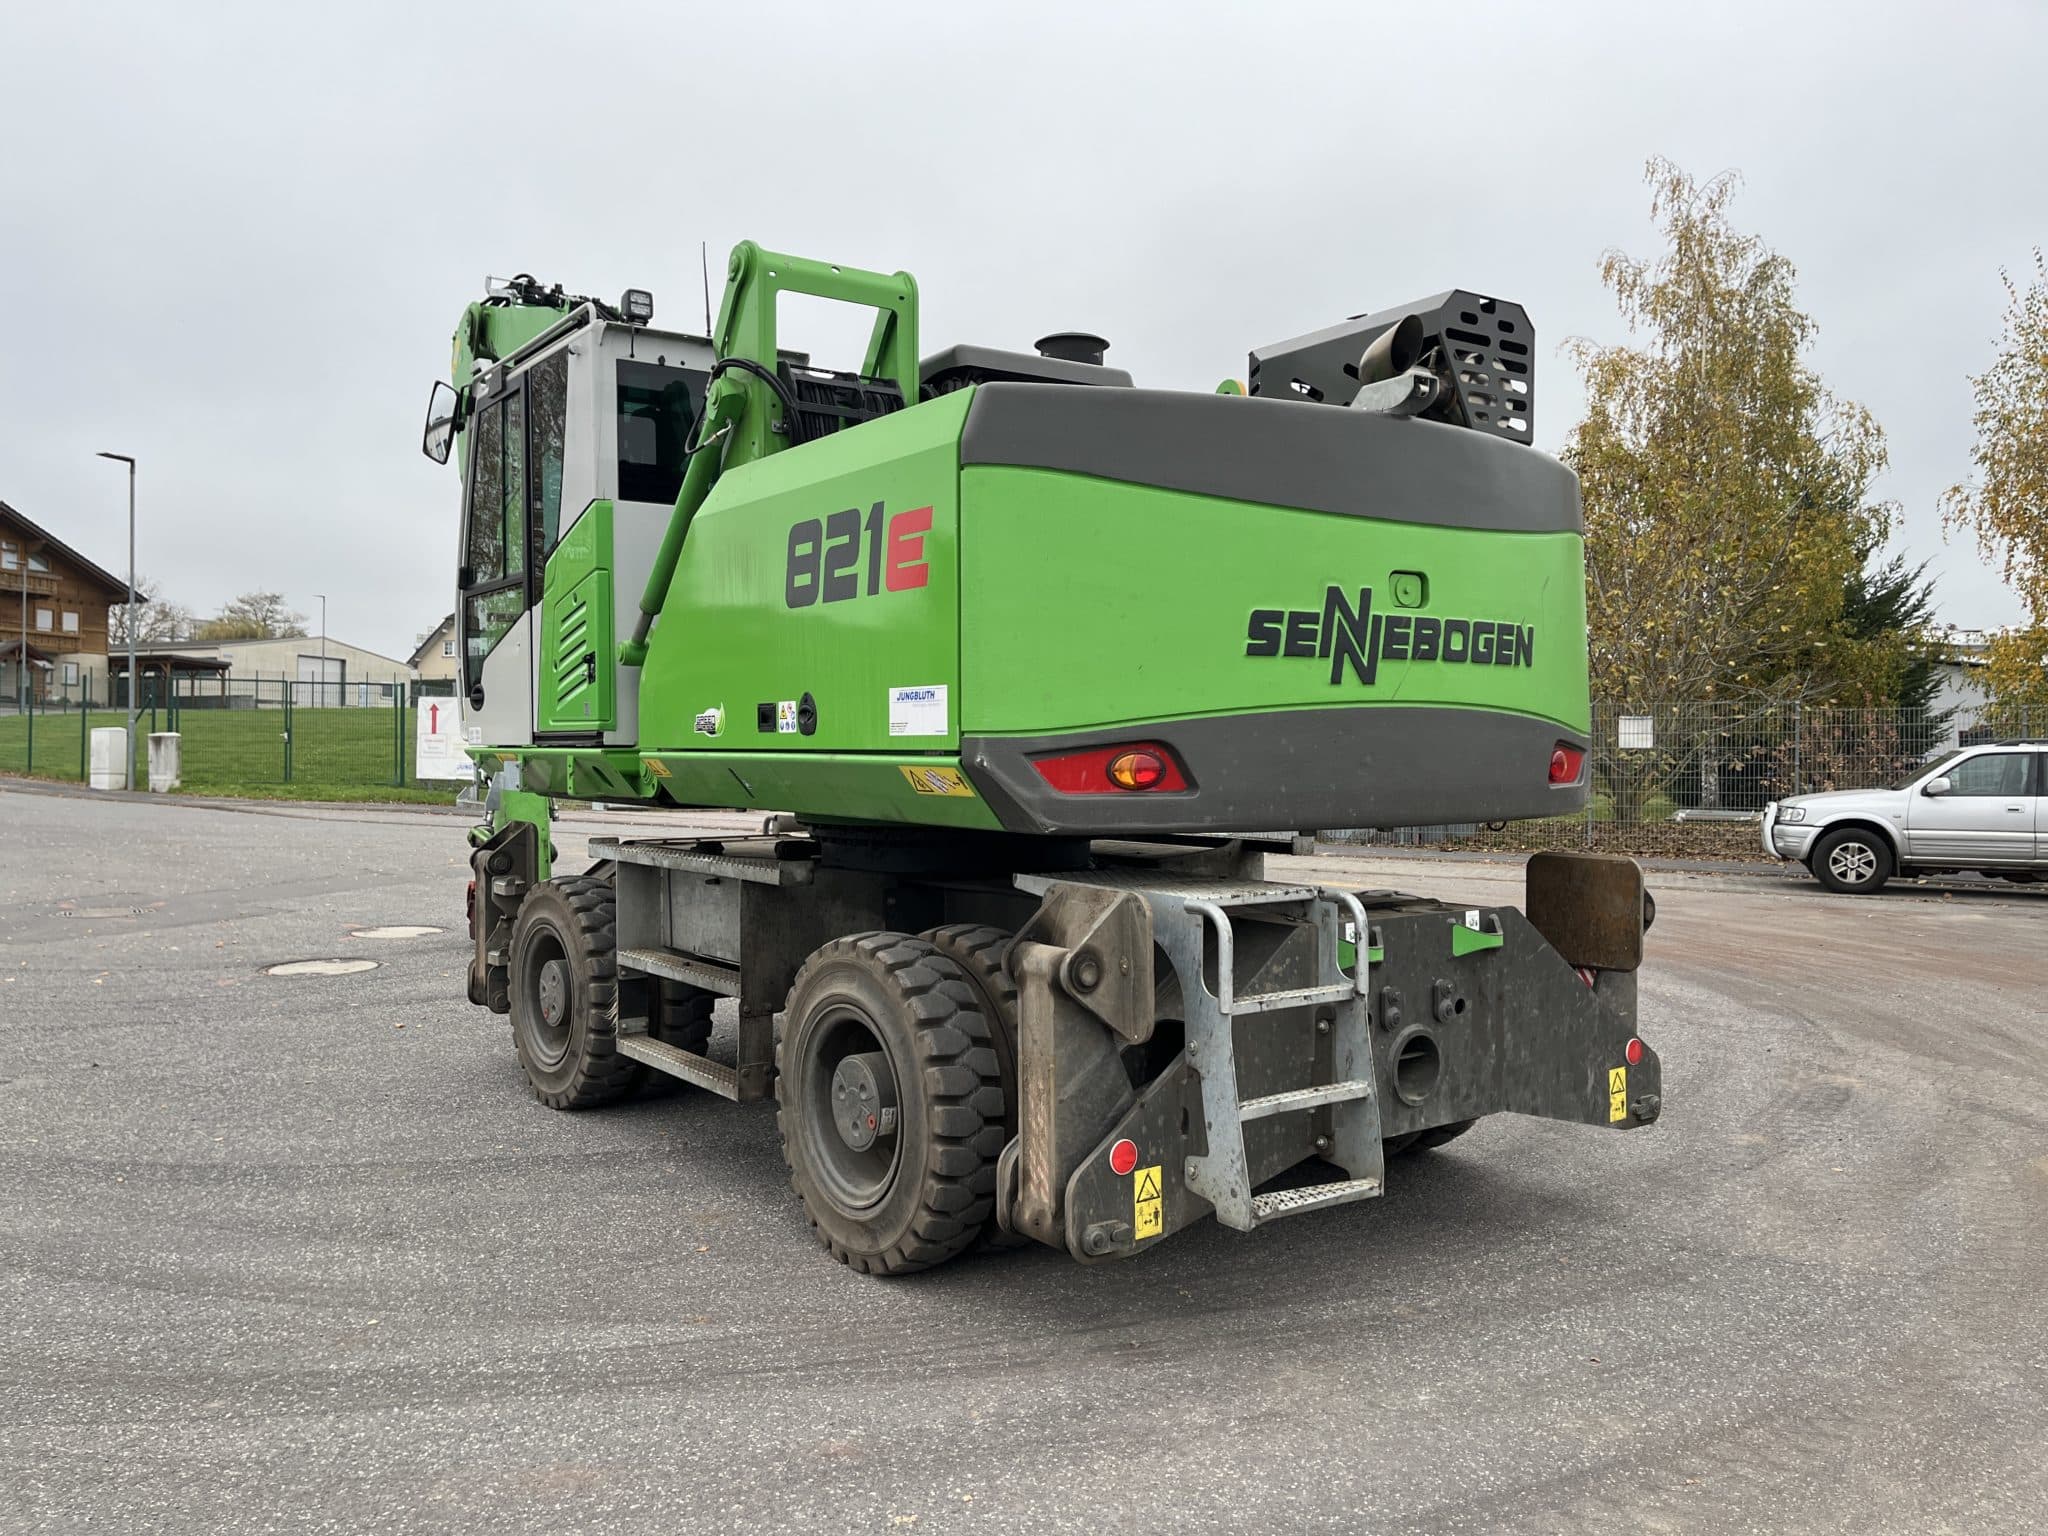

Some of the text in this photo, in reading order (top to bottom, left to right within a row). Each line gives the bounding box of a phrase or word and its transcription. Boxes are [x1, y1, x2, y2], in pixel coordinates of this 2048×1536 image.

[786, 501, 934, 609] 821E
[1246, 586, 1534, 685] SENNEBOGEN
[896, 690, 935, 701] JUNGBLUTH
